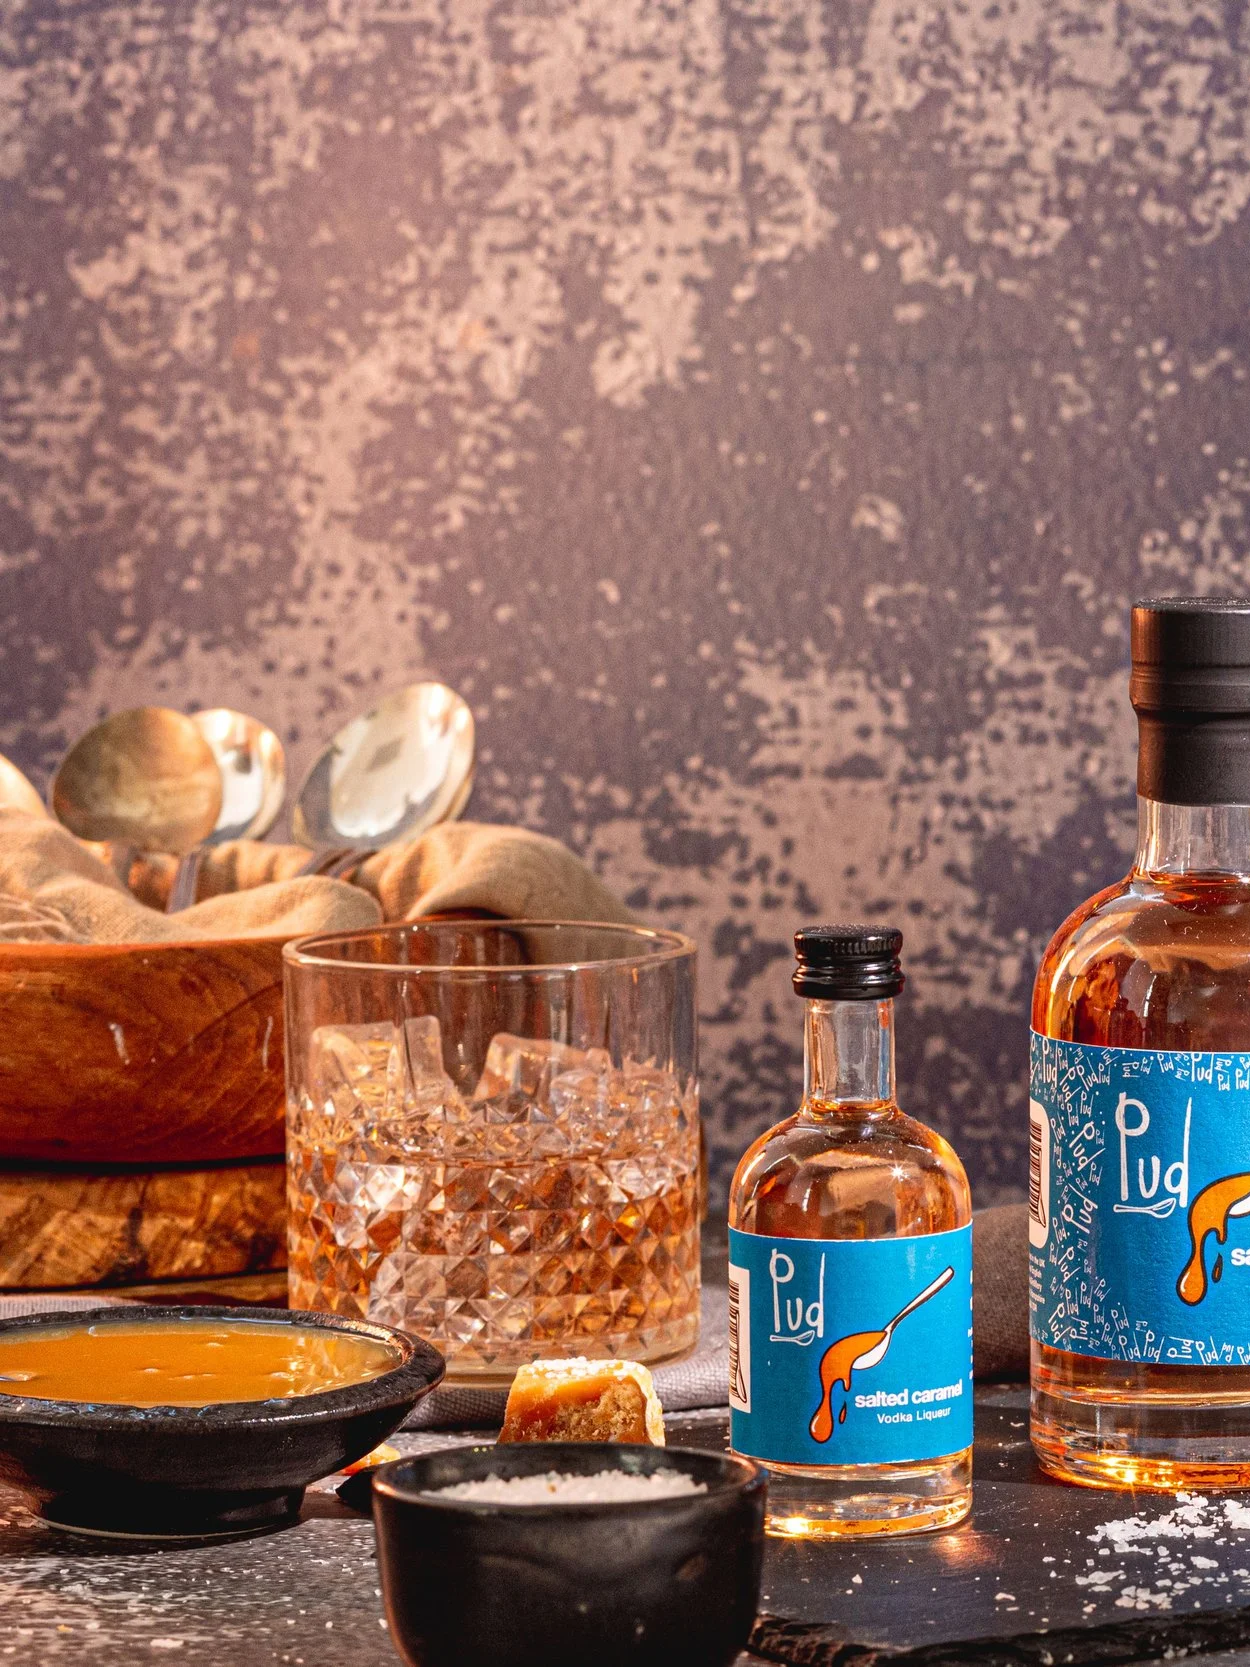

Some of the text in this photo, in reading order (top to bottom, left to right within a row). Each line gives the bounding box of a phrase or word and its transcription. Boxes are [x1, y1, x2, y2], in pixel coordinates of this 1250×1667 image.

[1157, 1052, 1174, 1073] Pud
[1235, 1068, 1250, 1090] Pud
[1069, 1120, 1106, 1170] Pud
[1115, 1092, 1192, 1208] Pud
[769, 1248, 826, 1338] Pud
[1143, 1330, 1165, 1362] Pud
[1195, 1336, 1219, 1365] Pud
[855, 1378, 963, 1408] salted caramel
[877, 1407, 951, 1424] Vodka Liqueur
